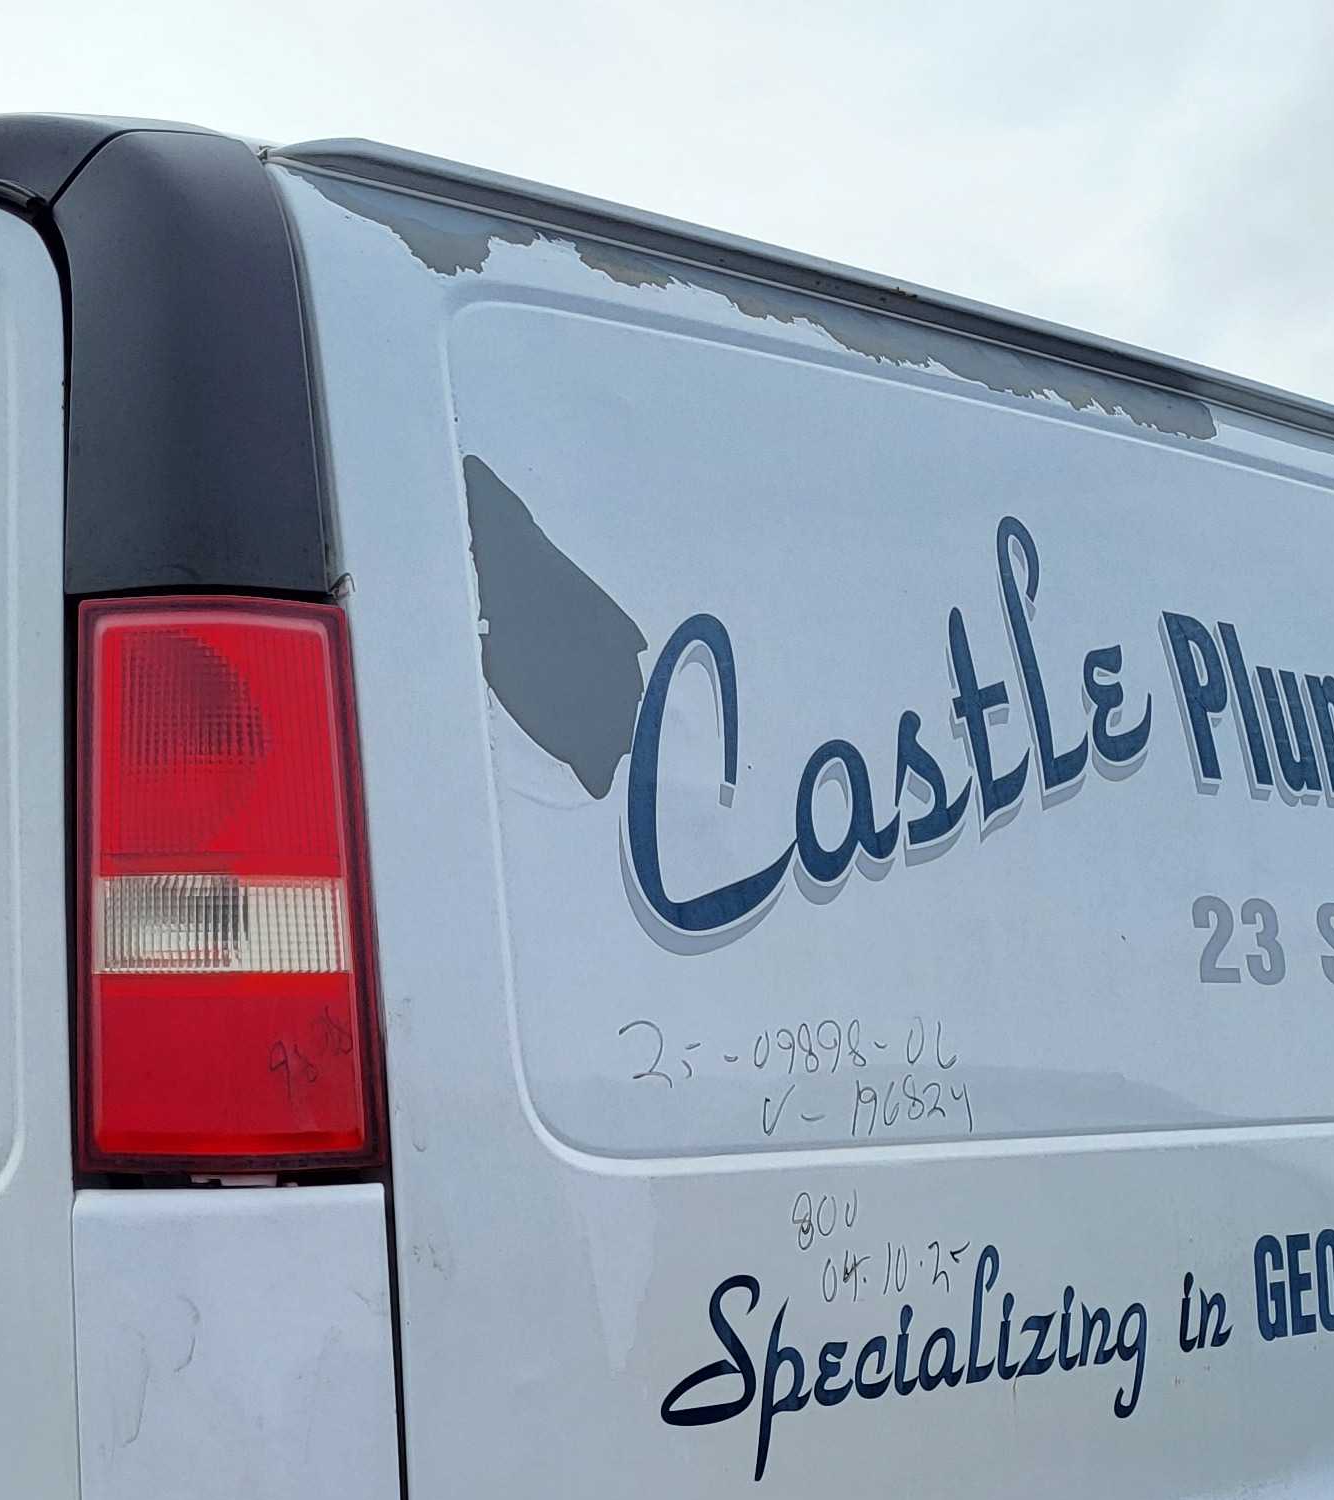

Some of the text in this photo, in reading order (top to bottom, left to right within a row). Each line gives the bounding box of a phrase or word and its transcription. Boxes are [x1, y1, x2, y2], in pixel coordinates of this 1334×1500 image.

[627, 515, 1152, 932] Castle
[1191, 894, 1287, 987] 23
[659, 1244, 1149, 1483] Specializing
[1175, 1271, 1233, 1353] in
